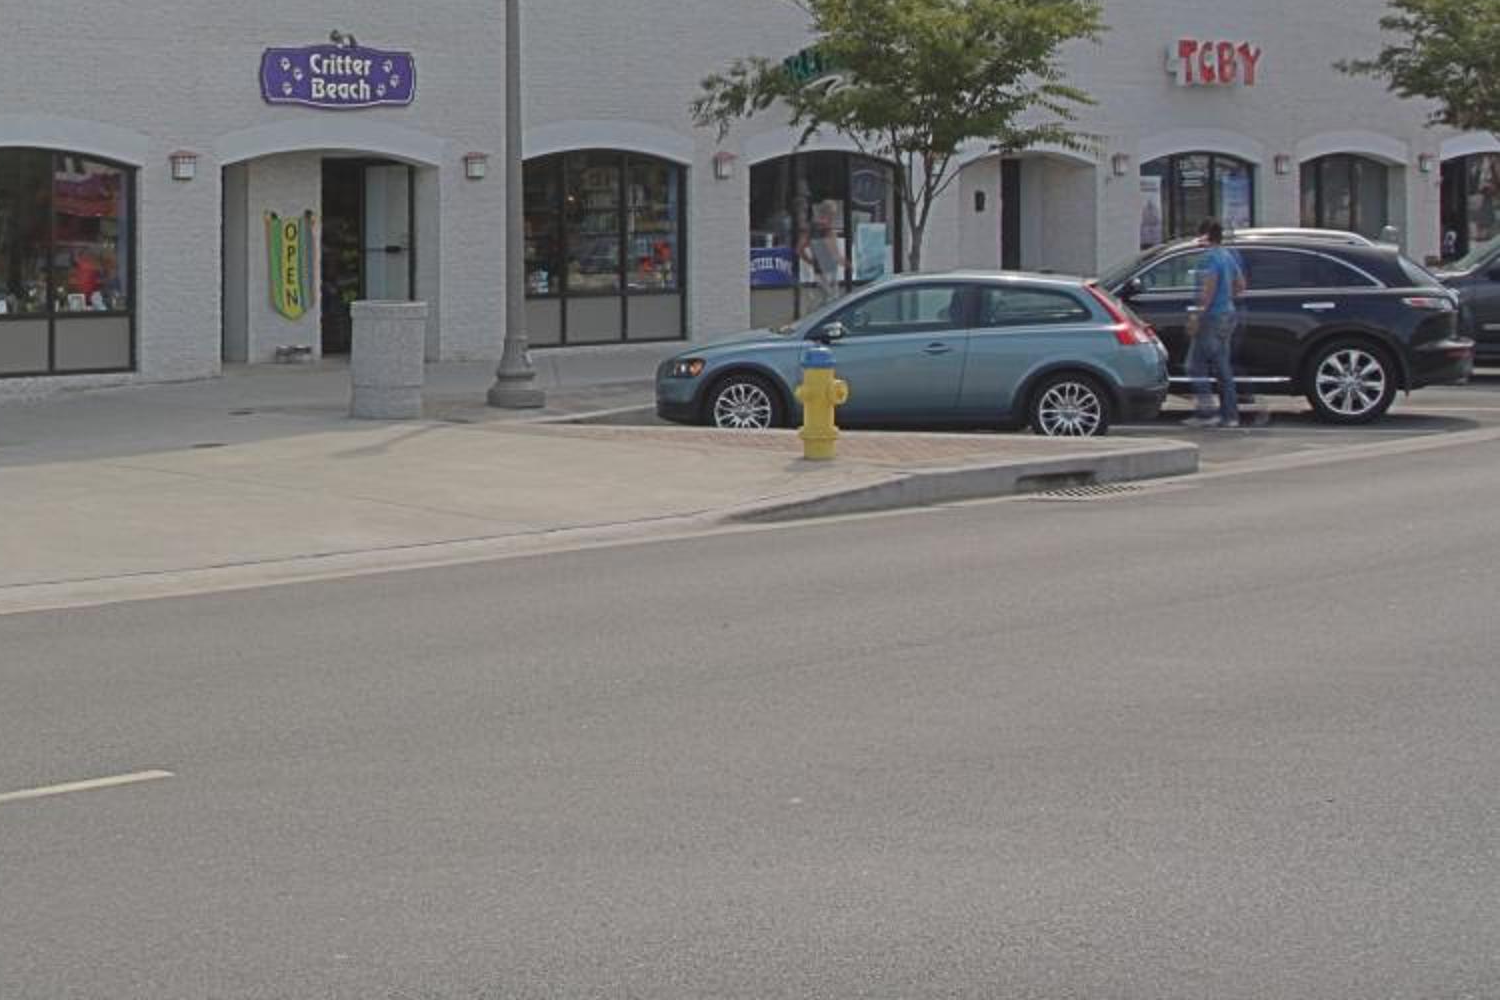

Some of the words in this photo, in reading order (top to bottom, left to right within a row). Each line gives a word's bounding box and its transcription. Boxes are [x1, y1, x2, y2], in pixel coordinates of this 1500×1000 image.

[309, 53, 372, 76] Critter
[1178, 39, 1262, 86] TCBY
[311, 77, 372, 99] Beach
[284, 222, 299, 307] OPEN
